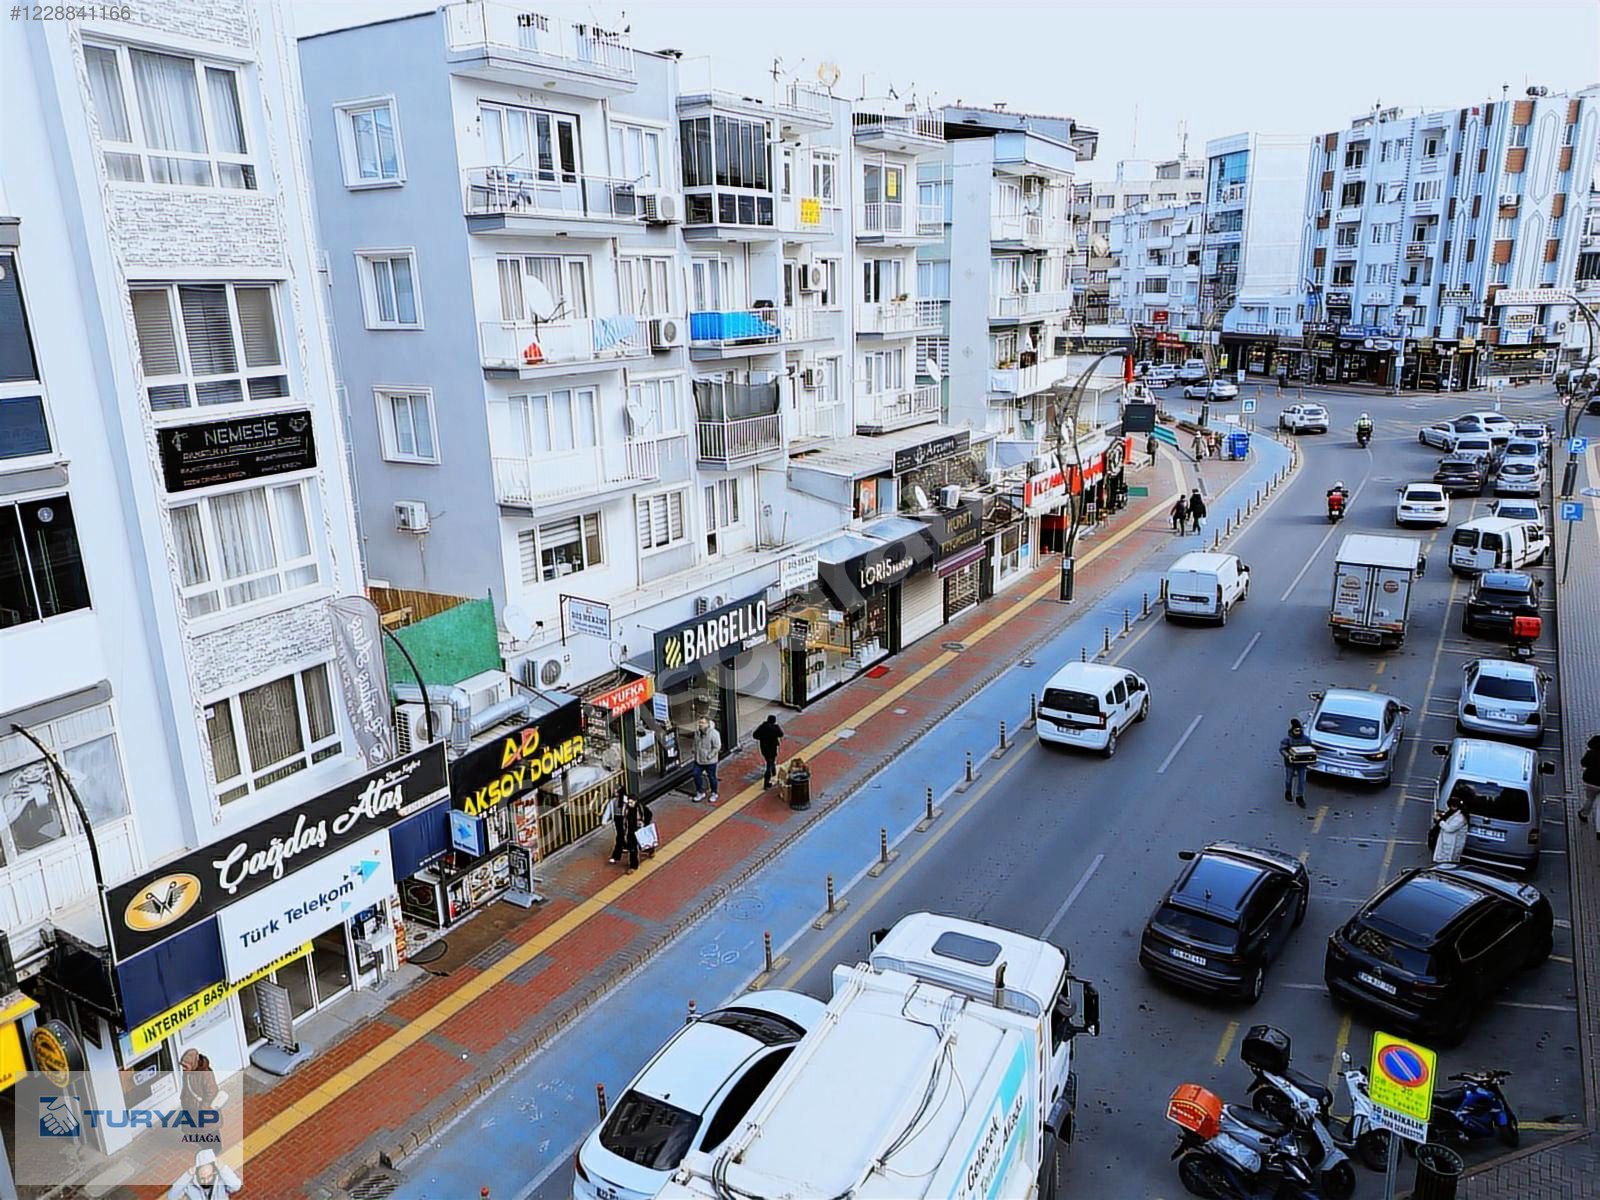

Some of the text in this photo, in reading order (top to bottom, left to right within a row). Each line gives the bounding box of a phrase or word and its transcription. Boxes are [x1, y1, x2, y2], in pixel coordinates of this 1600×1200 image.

[204, 419, 279, 447] NEMESİS
[860, 558, 893, 589] LORIS
[683, 599, 767, 665] BARGELLO
[612, 683, 645, 705] YUFKA
[464, 765, 526, 817] AKSOY
[530, 735, 584, 782] DÖNER
[212, 814, 327, 894] Çağdaş
[332, 774, 409, 835] Ataş
[240, 881, 355, 948] Türk Telekom
